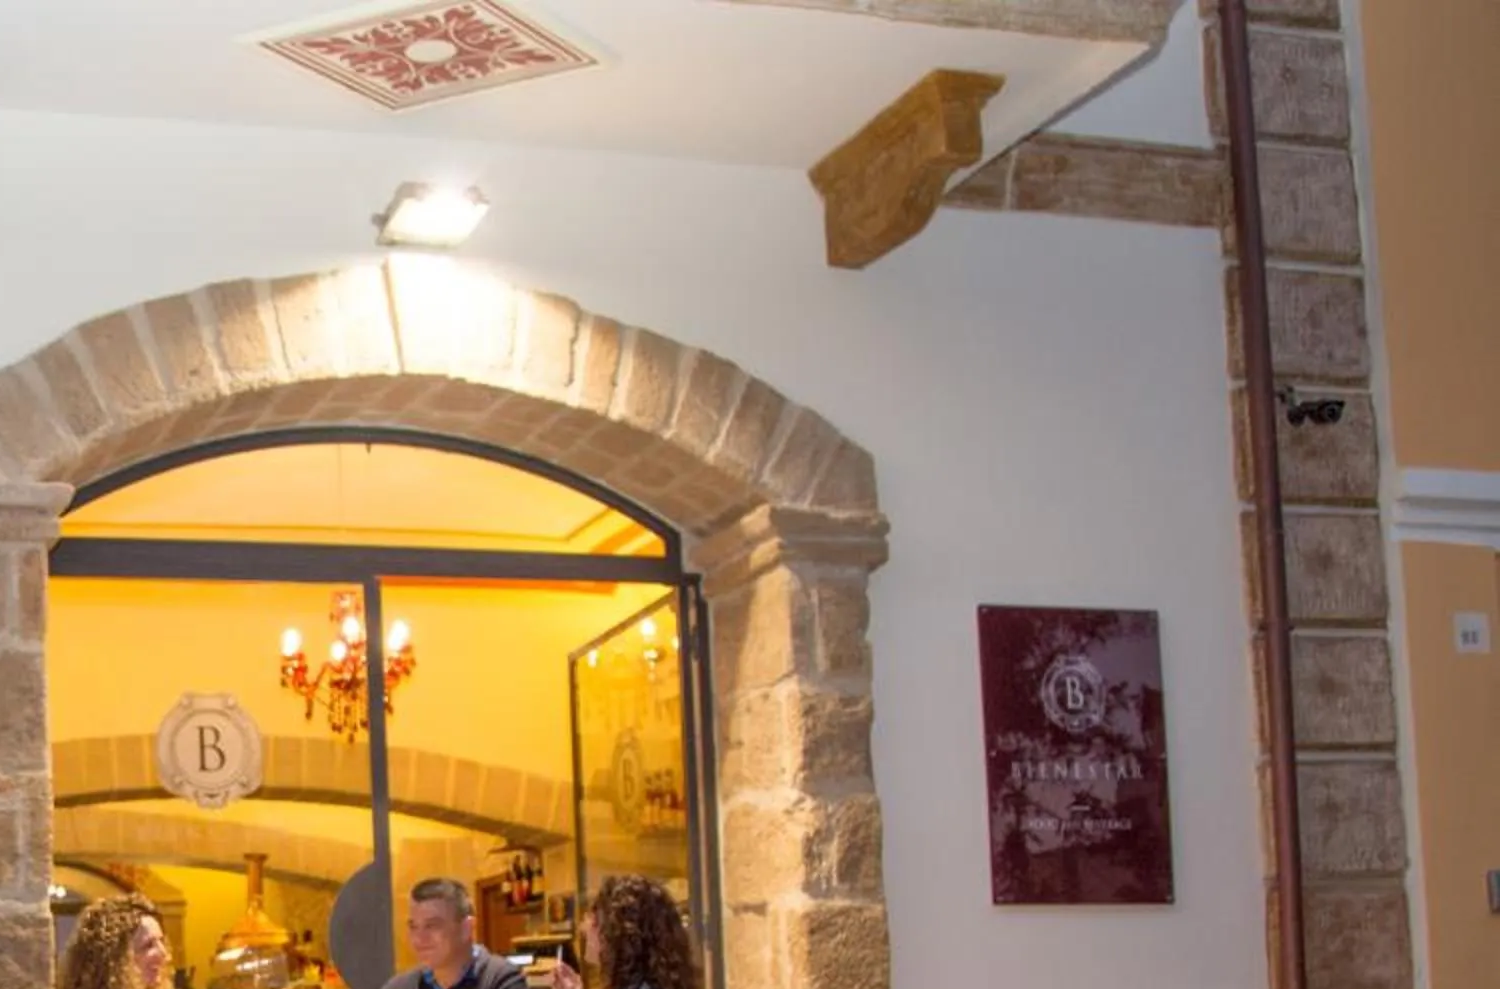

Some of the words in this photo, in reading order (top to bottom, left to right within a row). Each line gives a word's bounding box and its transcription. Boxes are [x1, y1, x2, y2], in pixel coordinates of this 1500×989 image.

[1065, 676, 1085, 710] B
[196, 725, 227, 772] B
[1010, 760, 1144, 780] BIENESTAR
